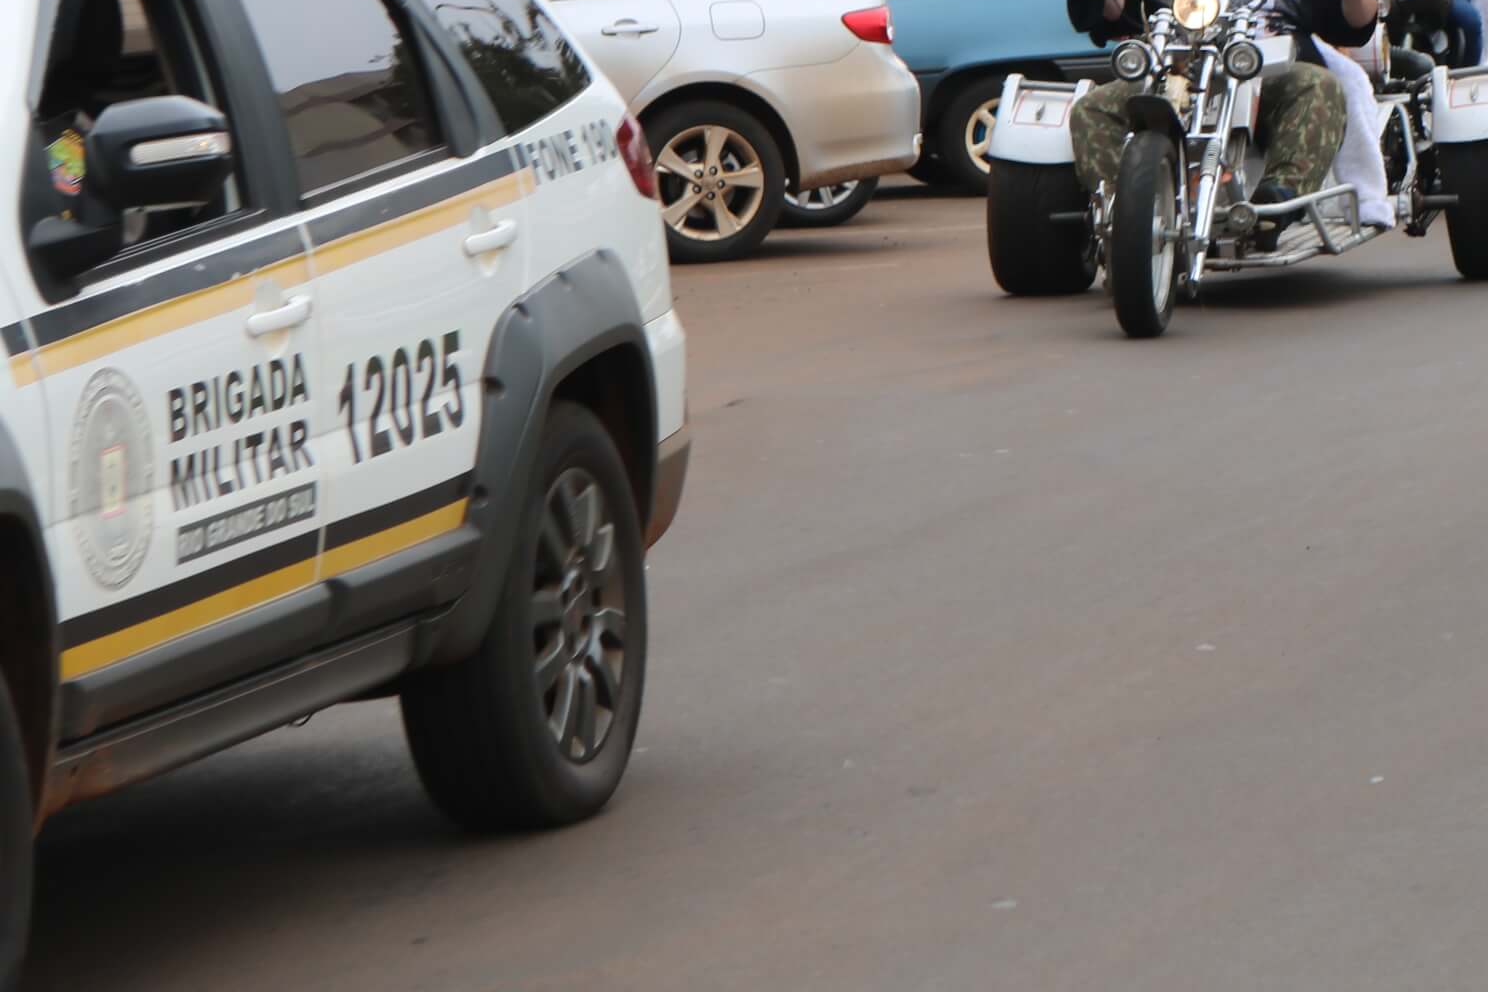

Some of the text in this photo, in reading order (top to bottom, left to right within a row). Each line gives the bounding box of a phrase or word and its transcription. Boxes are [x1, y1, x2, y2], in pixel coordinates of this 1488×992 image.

[168, 351, 311, 444] BRIGADA
[337, 328, 465, 466] 12025
[170, 418, 315, 513] MILITAR
